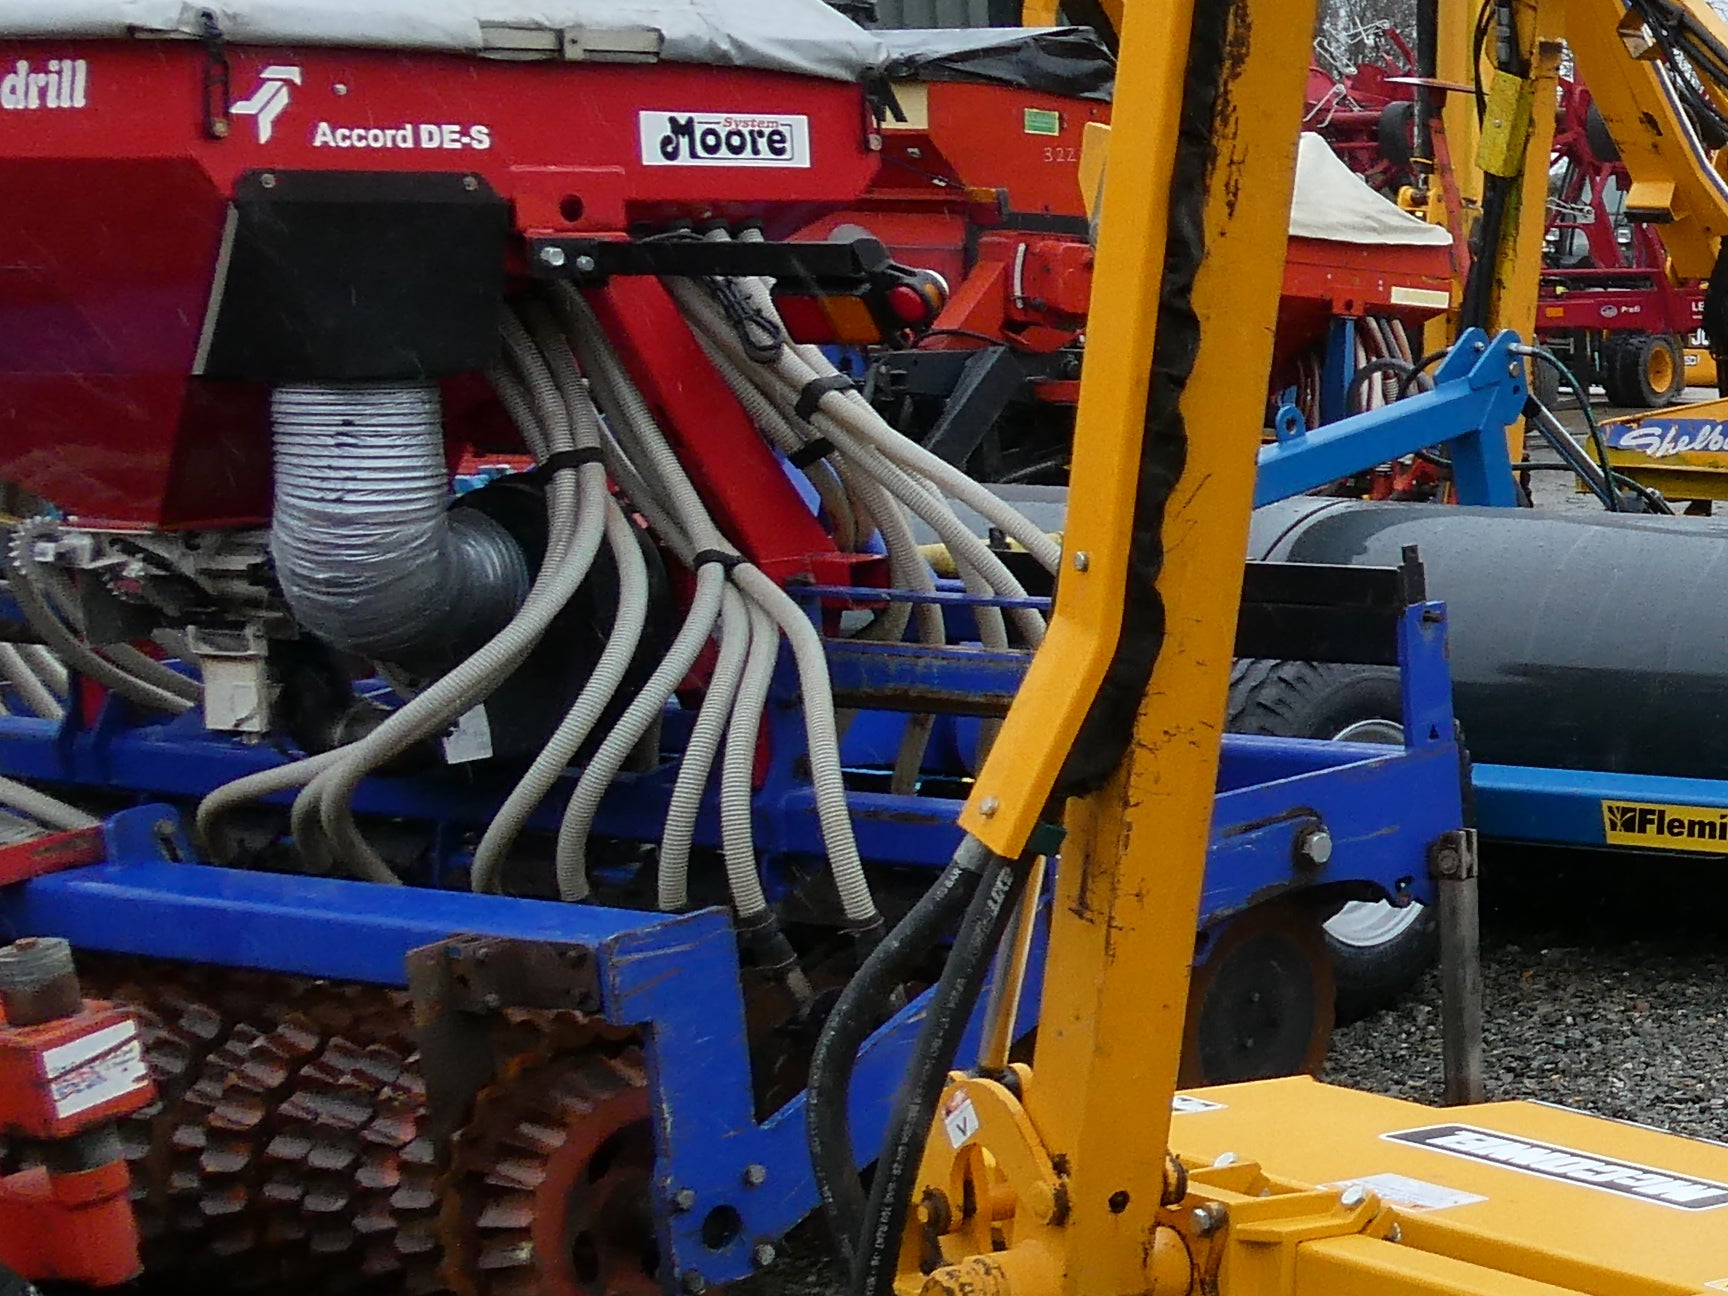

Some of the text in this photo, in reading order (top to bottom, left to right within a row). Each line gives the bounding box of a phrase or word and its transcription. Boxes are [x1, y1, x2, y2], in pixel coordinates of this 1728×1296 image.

[1, 58, 87, 110] drill
[313, 122, 491, 151] Accord DE-S
[659, 115, 788, 162] Moore
[722, 116, 780, 131] System
